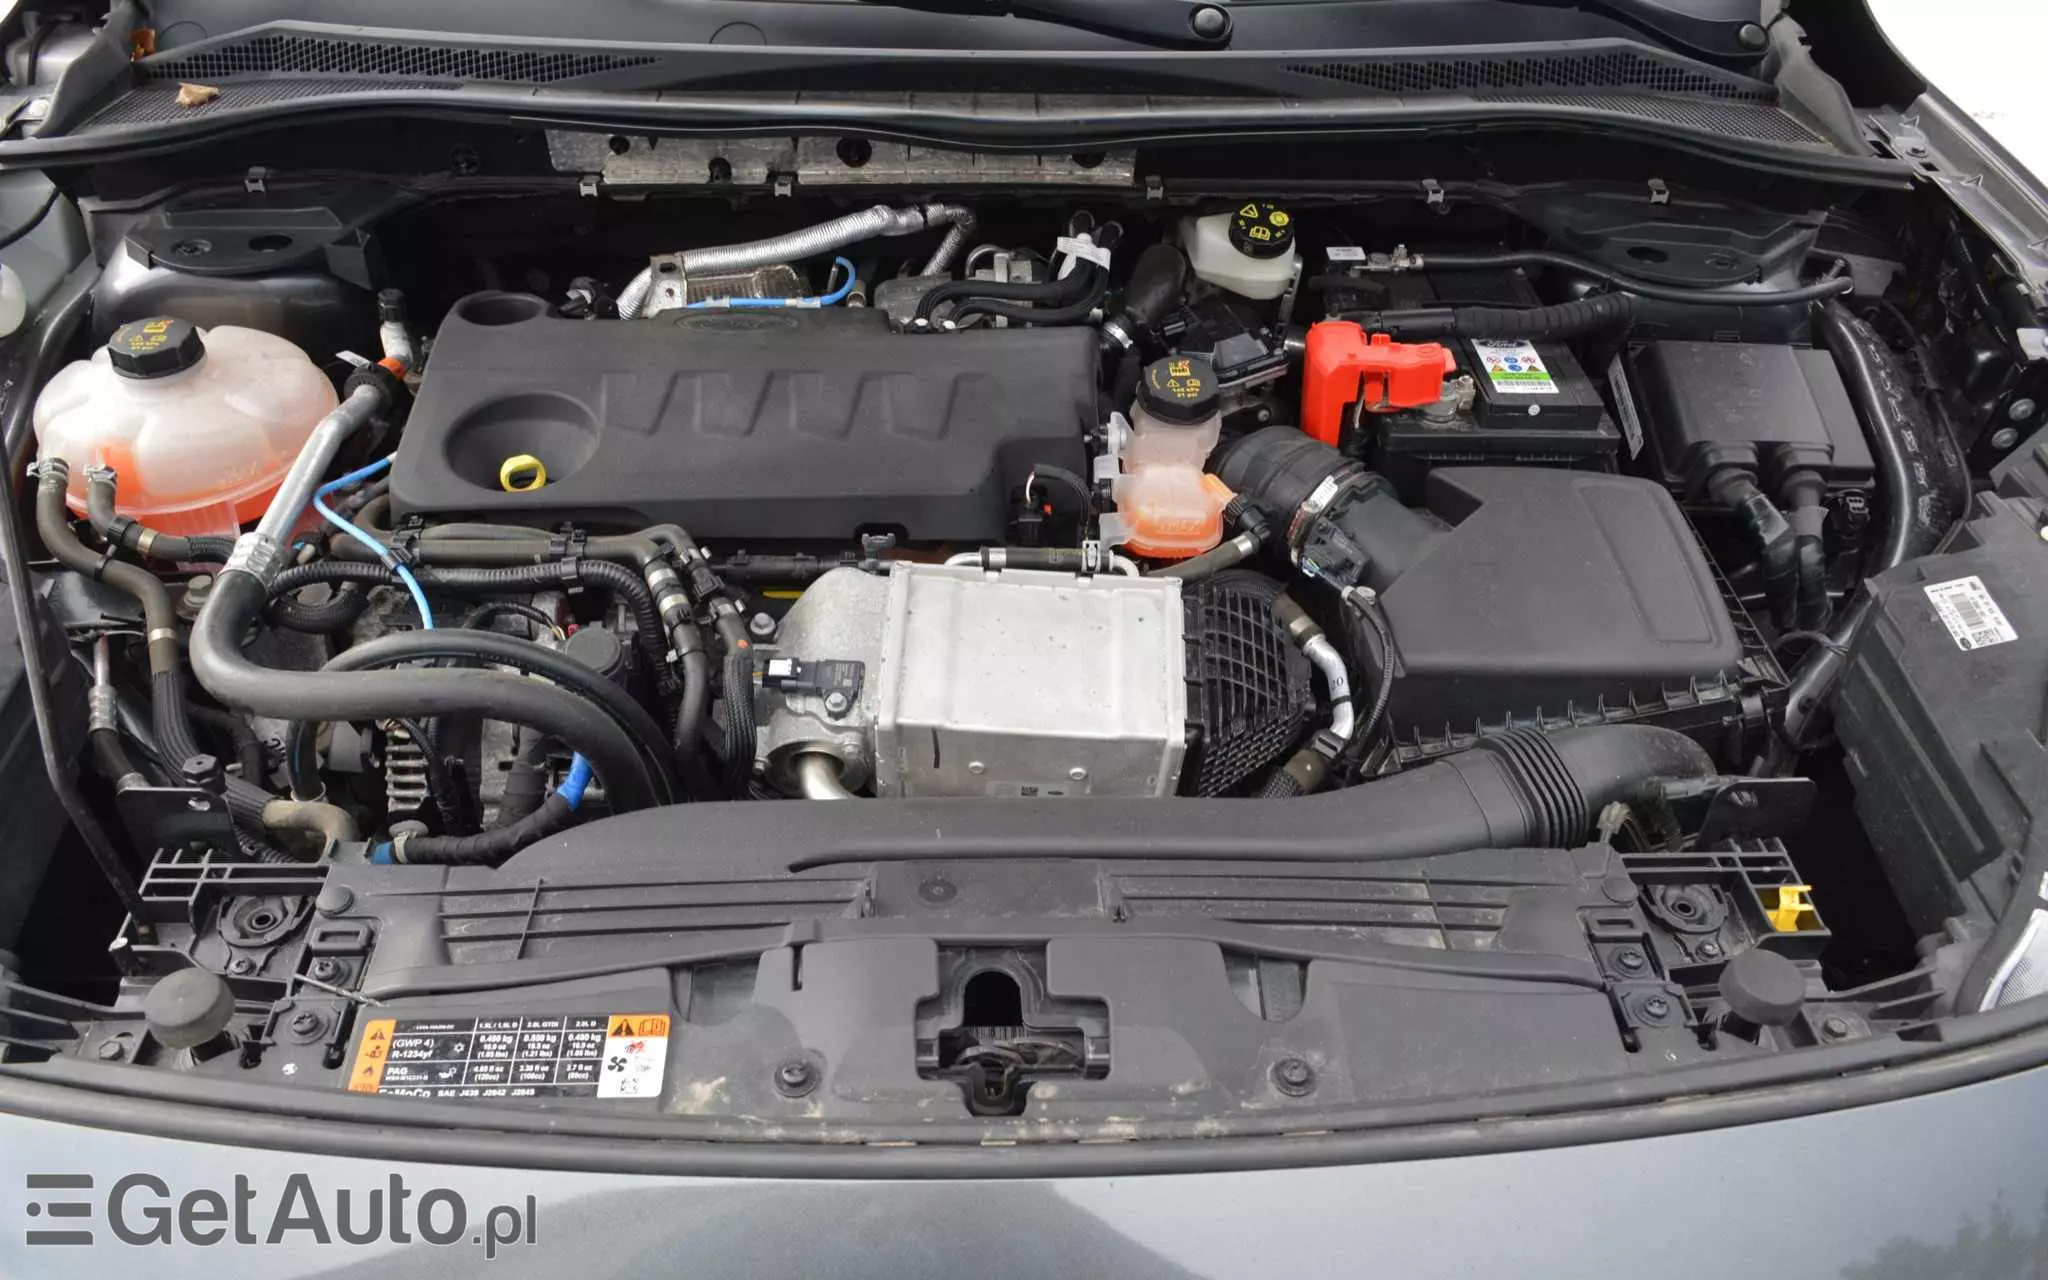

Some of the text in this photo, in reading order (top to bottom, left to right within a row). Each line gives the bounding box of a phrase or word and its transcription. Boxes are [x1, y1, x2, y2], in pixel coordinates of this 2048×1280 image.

[546, 1033, 557, 1043] kg
[590, 1033, 601, 1043] kg
[393, 1038, 434, 1049] (GWP 4)
[391, 1050, 433, 1060] R-1234yf
